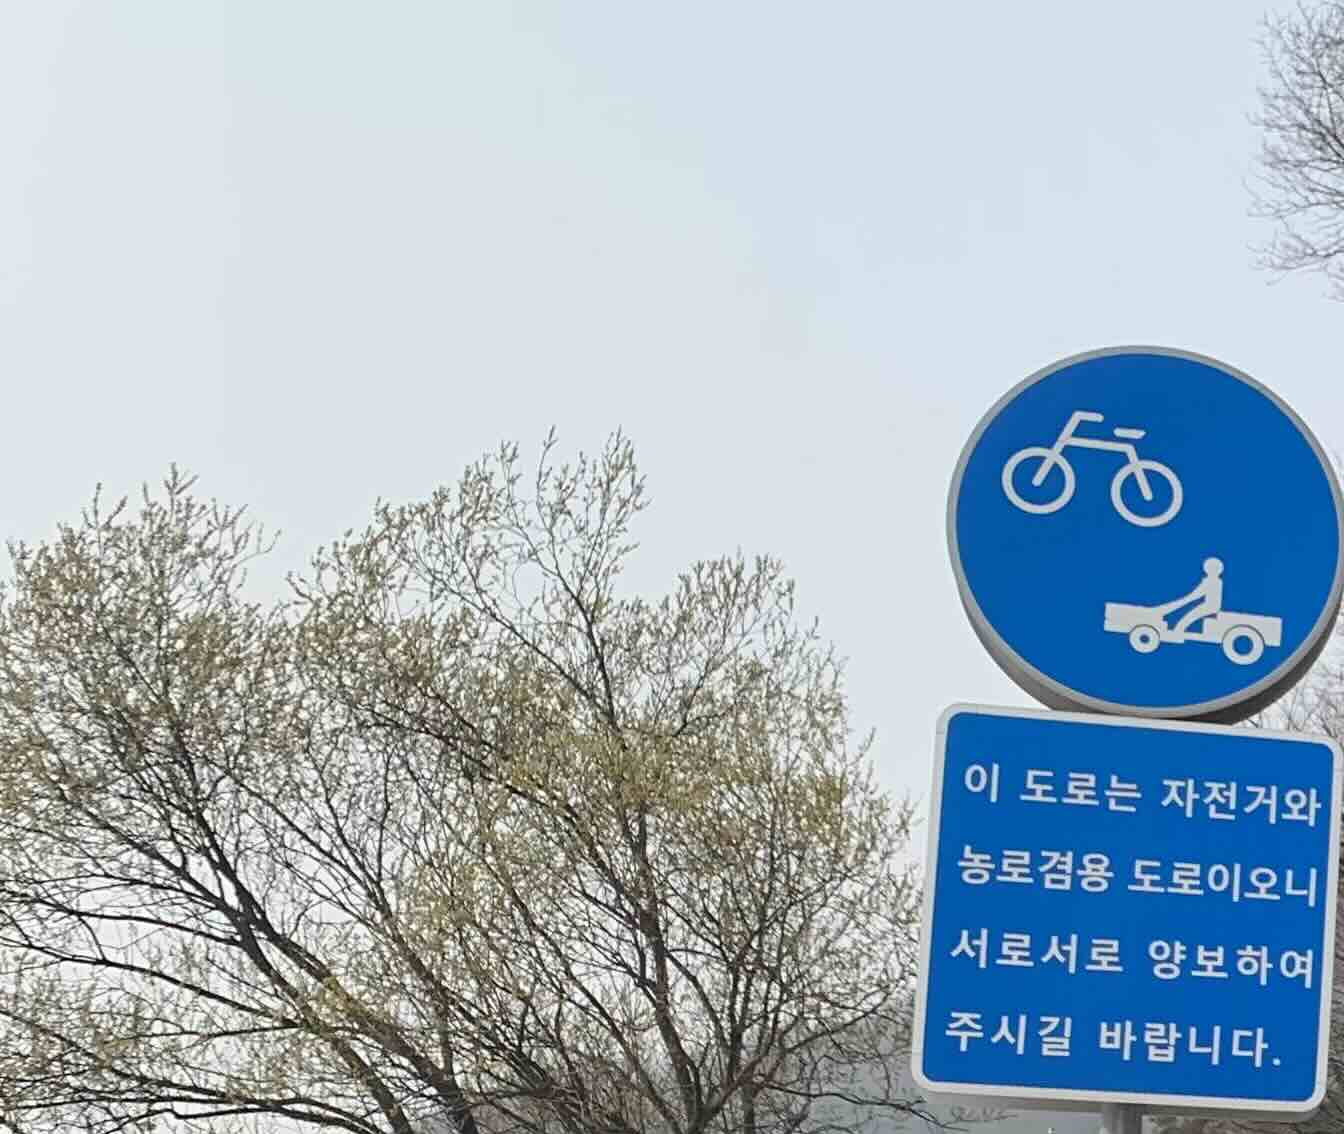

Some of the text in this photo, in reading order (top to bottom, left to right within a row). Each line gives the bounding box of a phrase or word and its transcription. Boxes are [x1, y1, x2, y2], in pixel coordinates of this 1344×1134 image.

[964, 763, 1322, 827] 이 도로는 자전거와
[957, 844, 1318, 907] 농로겸용 도로이오니
[949, 927, 1314, 989] 서로서로 양보하여
[944, 1010, 1282, 1068] 주시길 바랍니다.
